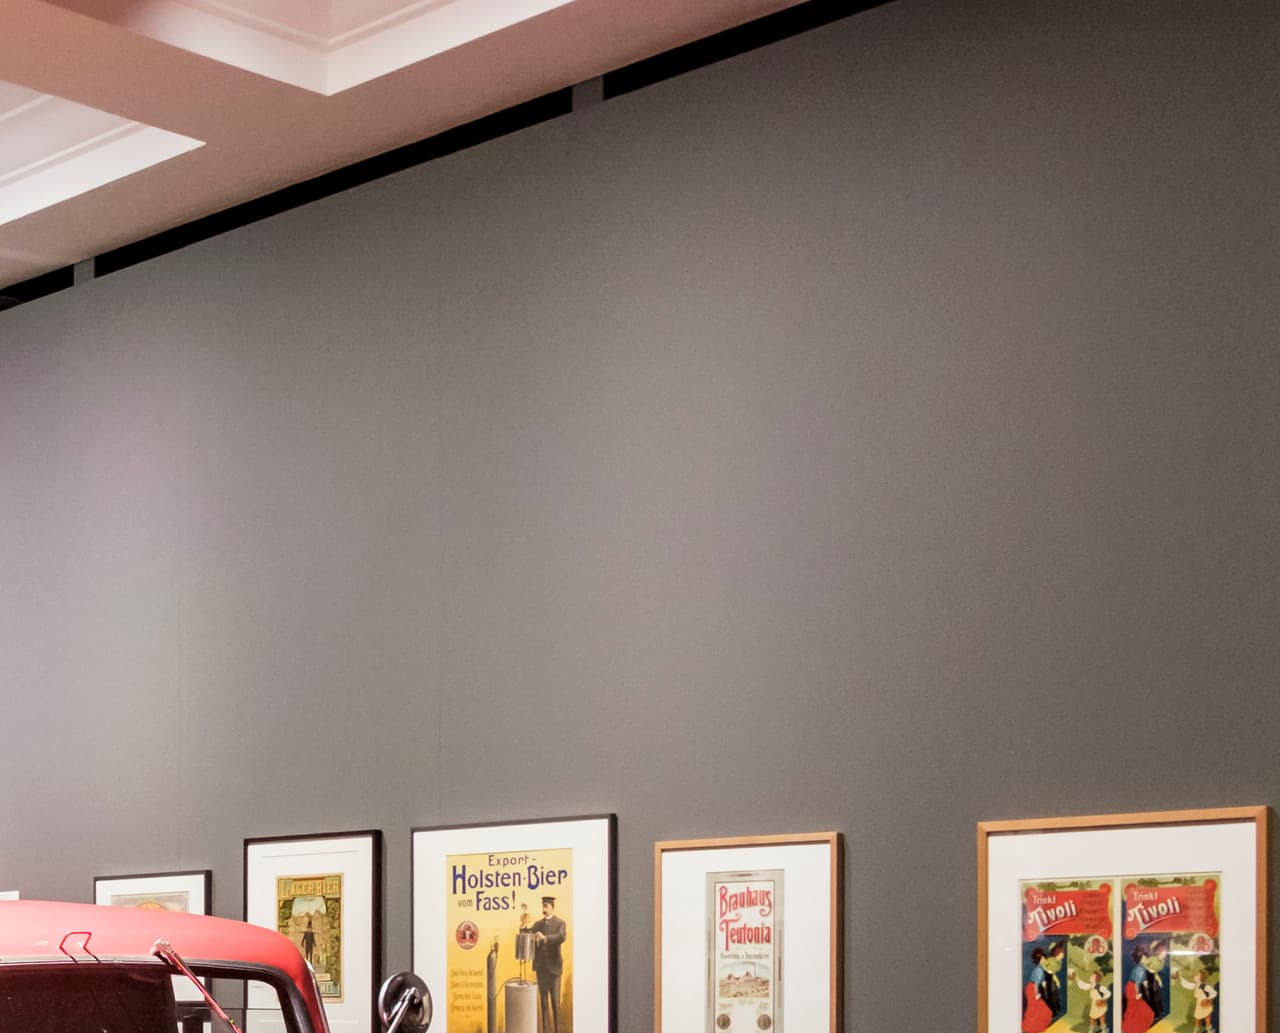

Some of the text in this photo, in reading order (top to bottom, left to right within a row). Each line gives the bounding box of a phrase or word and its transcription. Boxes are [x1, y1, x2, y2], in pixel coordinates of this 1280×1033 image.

[458, 890, 516, 911] vom Fass!
[720, 885, 772, 918] Brauhaus
[1028, 899, 1078, 932] Tivoli
[1127, 896, 1181, 931] Tivoli
[720, 912, 771, 951] Teutonia
